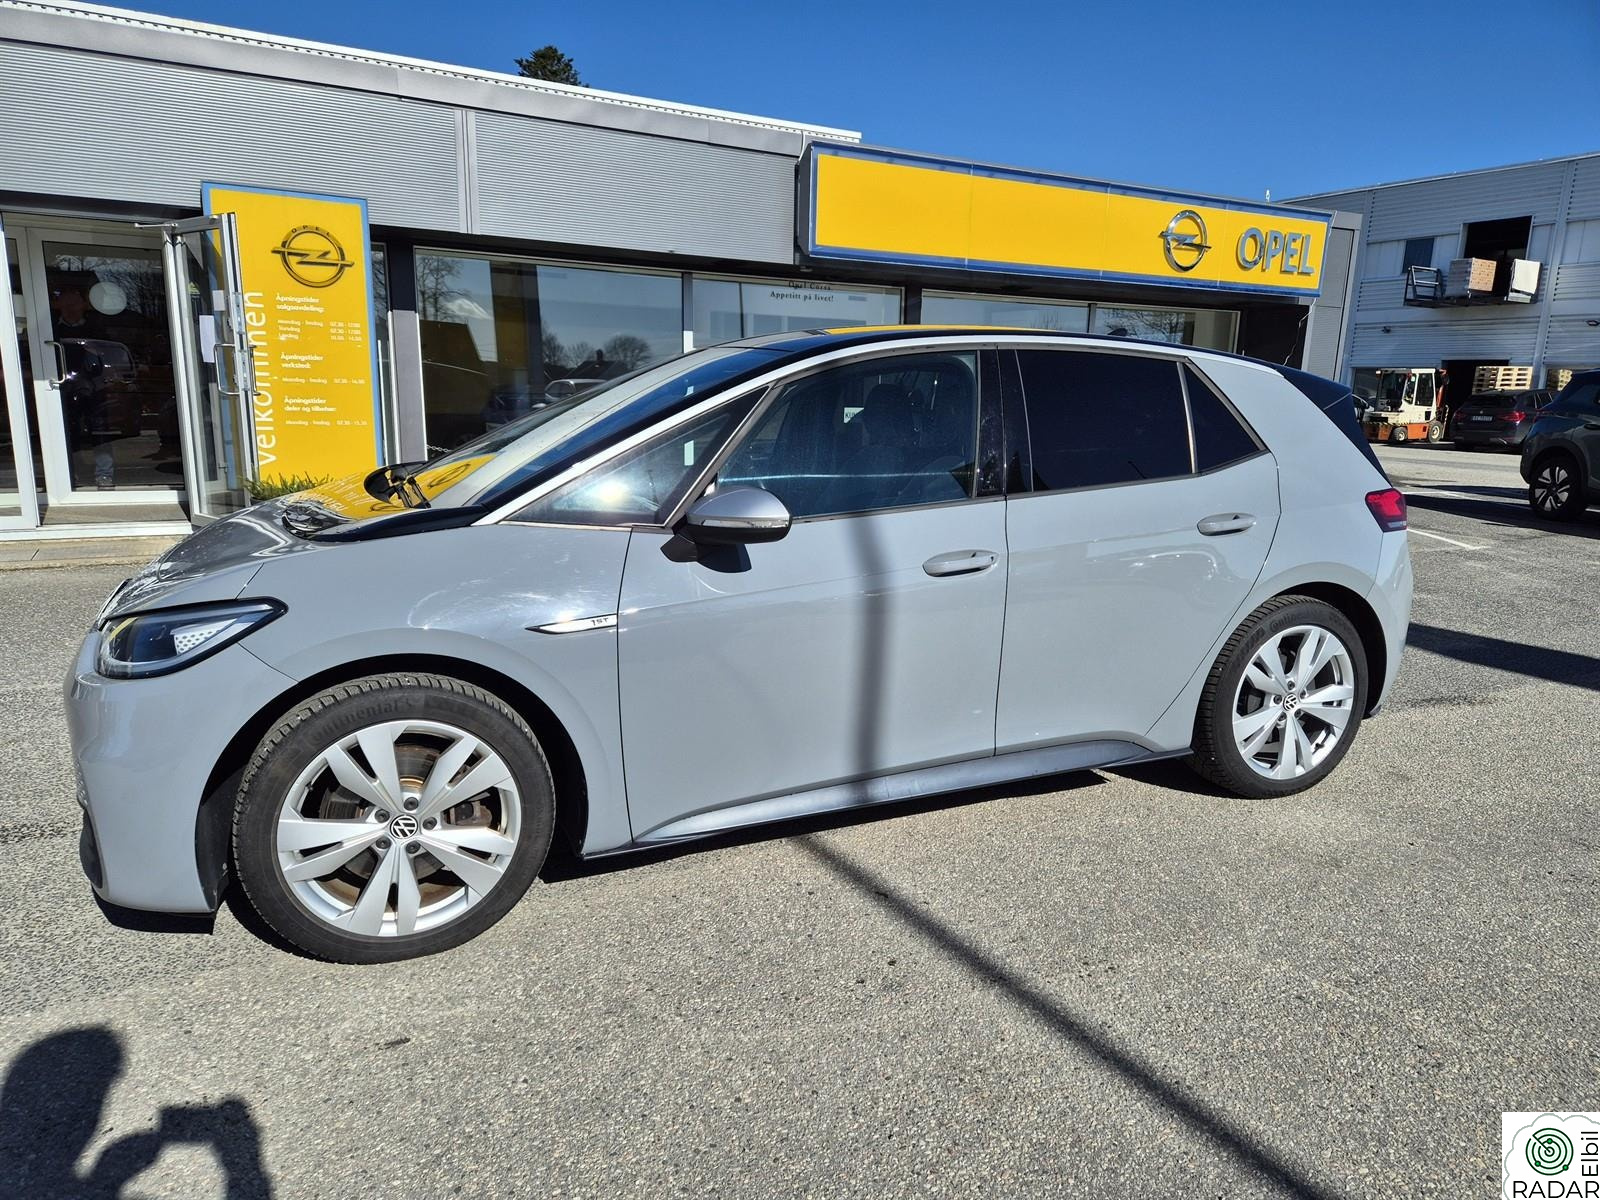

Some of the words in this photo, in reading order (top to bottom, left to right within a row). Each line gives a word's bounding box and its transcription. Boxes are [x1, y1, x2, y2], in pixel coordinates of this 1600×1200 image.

[1236, 227, 1315, 275] OPEL
[803, 293, 812, 302] på
[243, 291, 277, 467] velkommen
[590, 617, 609, 626] 1ST
